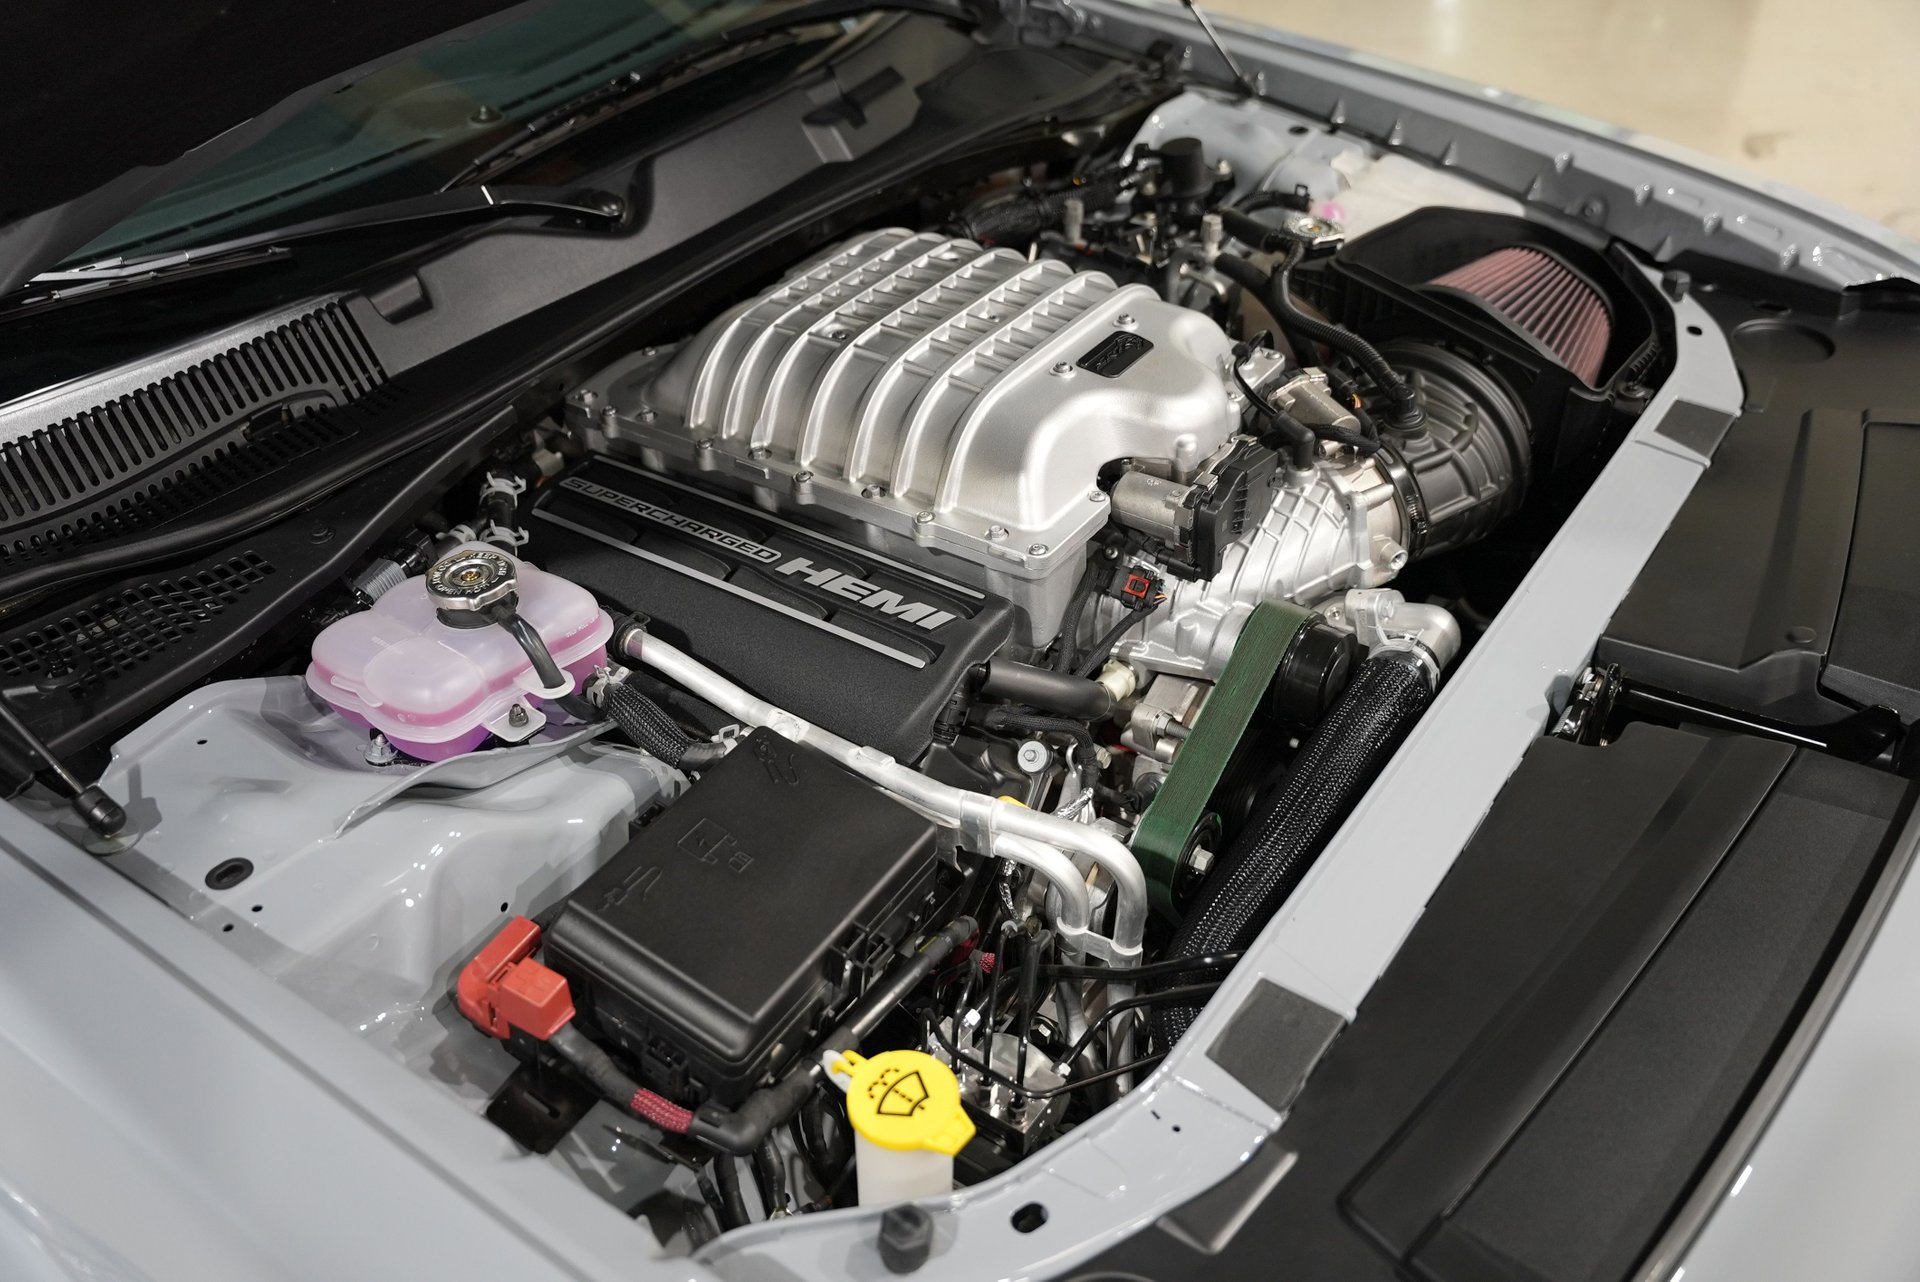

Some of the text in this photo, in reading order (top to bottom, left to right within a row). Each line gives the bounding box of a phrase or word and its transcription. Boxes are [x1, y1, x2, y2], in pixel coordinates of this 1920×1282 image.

[437, 583, 463, 596] OPEN
[563, 477, 958, 631] SUPERCHARGED HEMI
